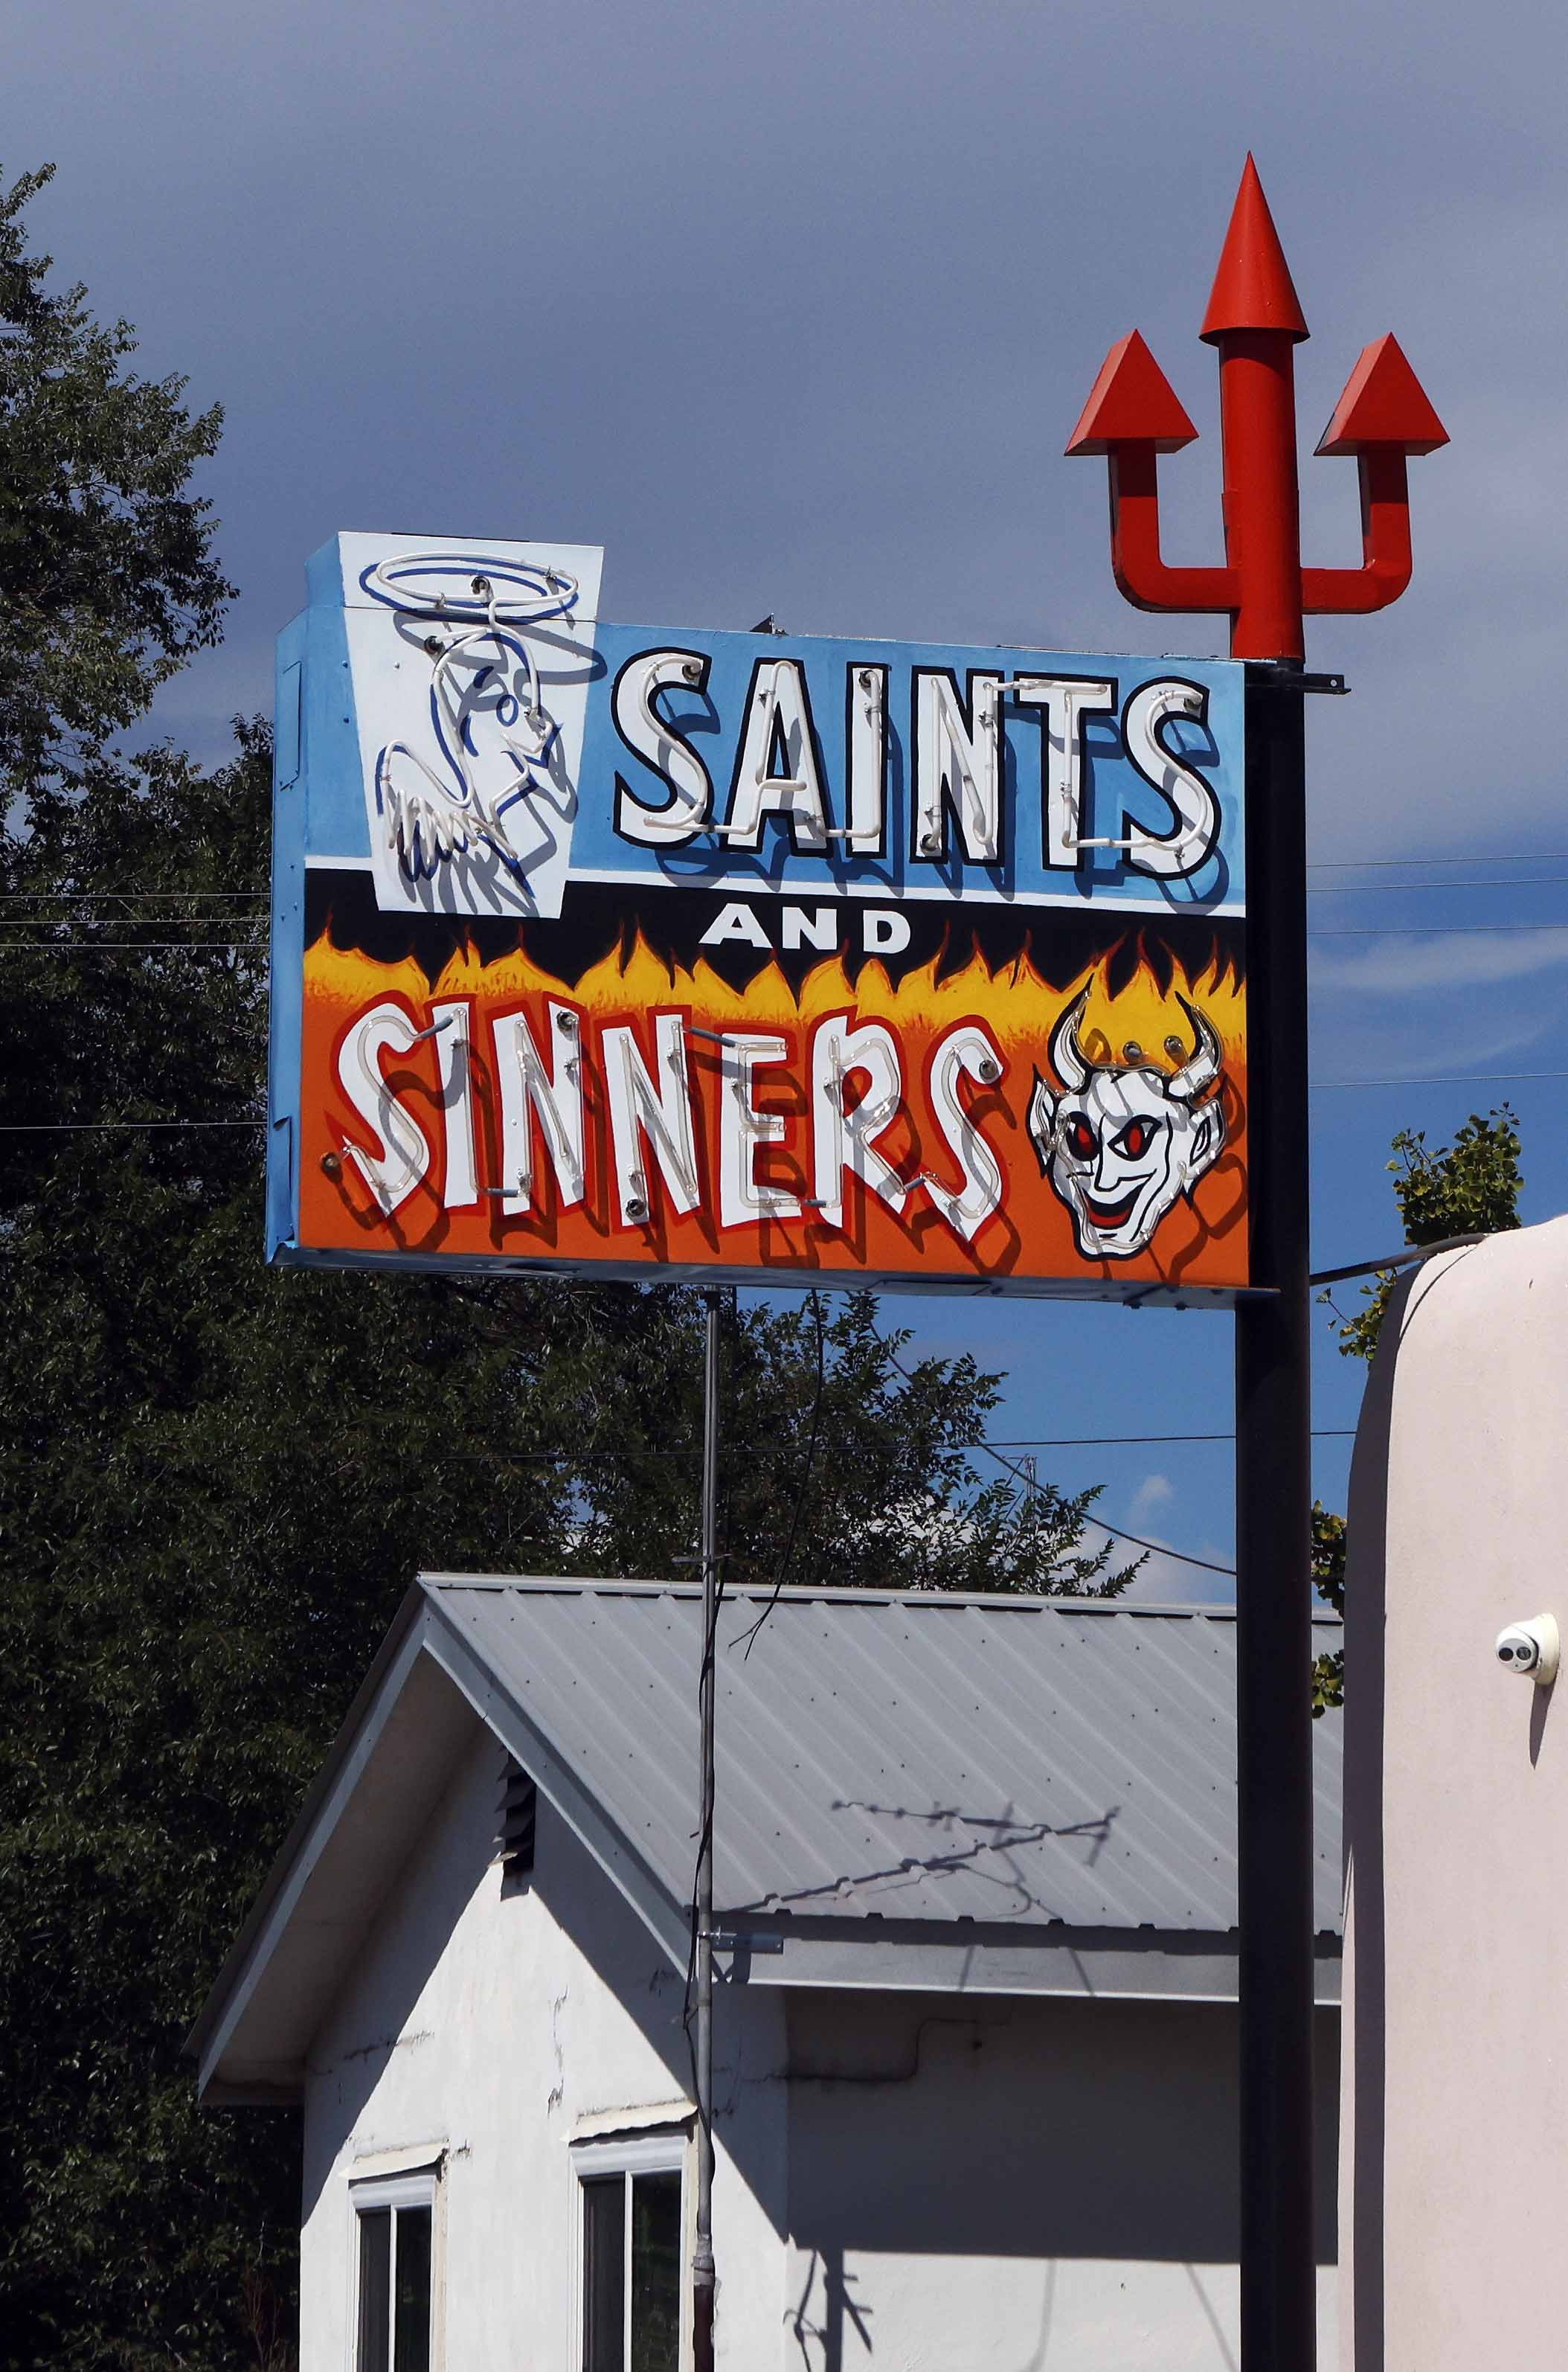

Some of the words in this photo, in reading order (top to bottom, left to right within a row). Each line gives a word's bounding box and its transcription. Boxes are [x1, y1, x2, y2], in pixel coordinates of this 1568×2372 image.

[613, 649, 1220, 876] SAINTS
[699, 904, 912, 953] AND
[332, 993, 1006, 1248] SINNERS
